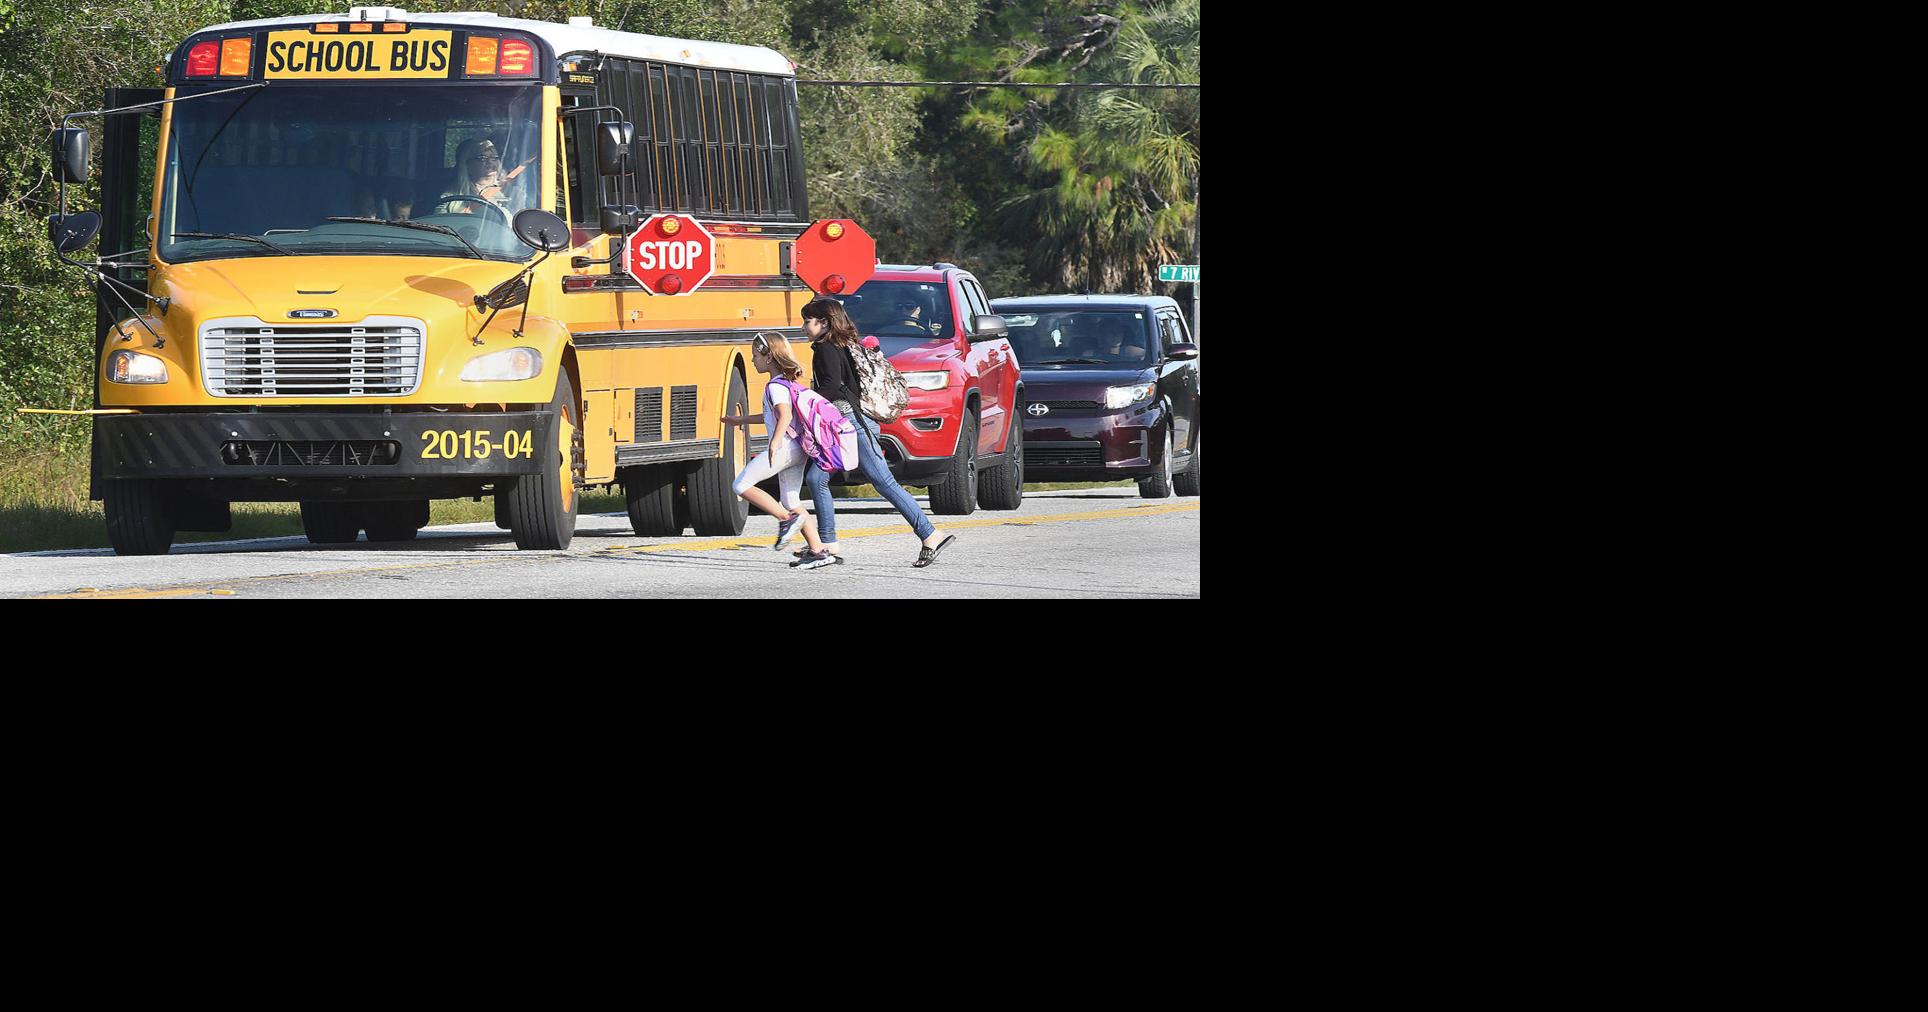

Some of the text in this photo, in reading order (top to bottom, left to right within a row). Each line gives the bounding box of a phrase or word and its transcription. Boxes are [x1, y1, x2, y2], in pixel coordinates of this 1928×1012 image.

[268, 40, 448, 72] SCHOOL BUS
[639, 240, 703, 270] STOP
[1170, 266, 1178, 280] 7
[421, 429, 534, 459] 2015-04
